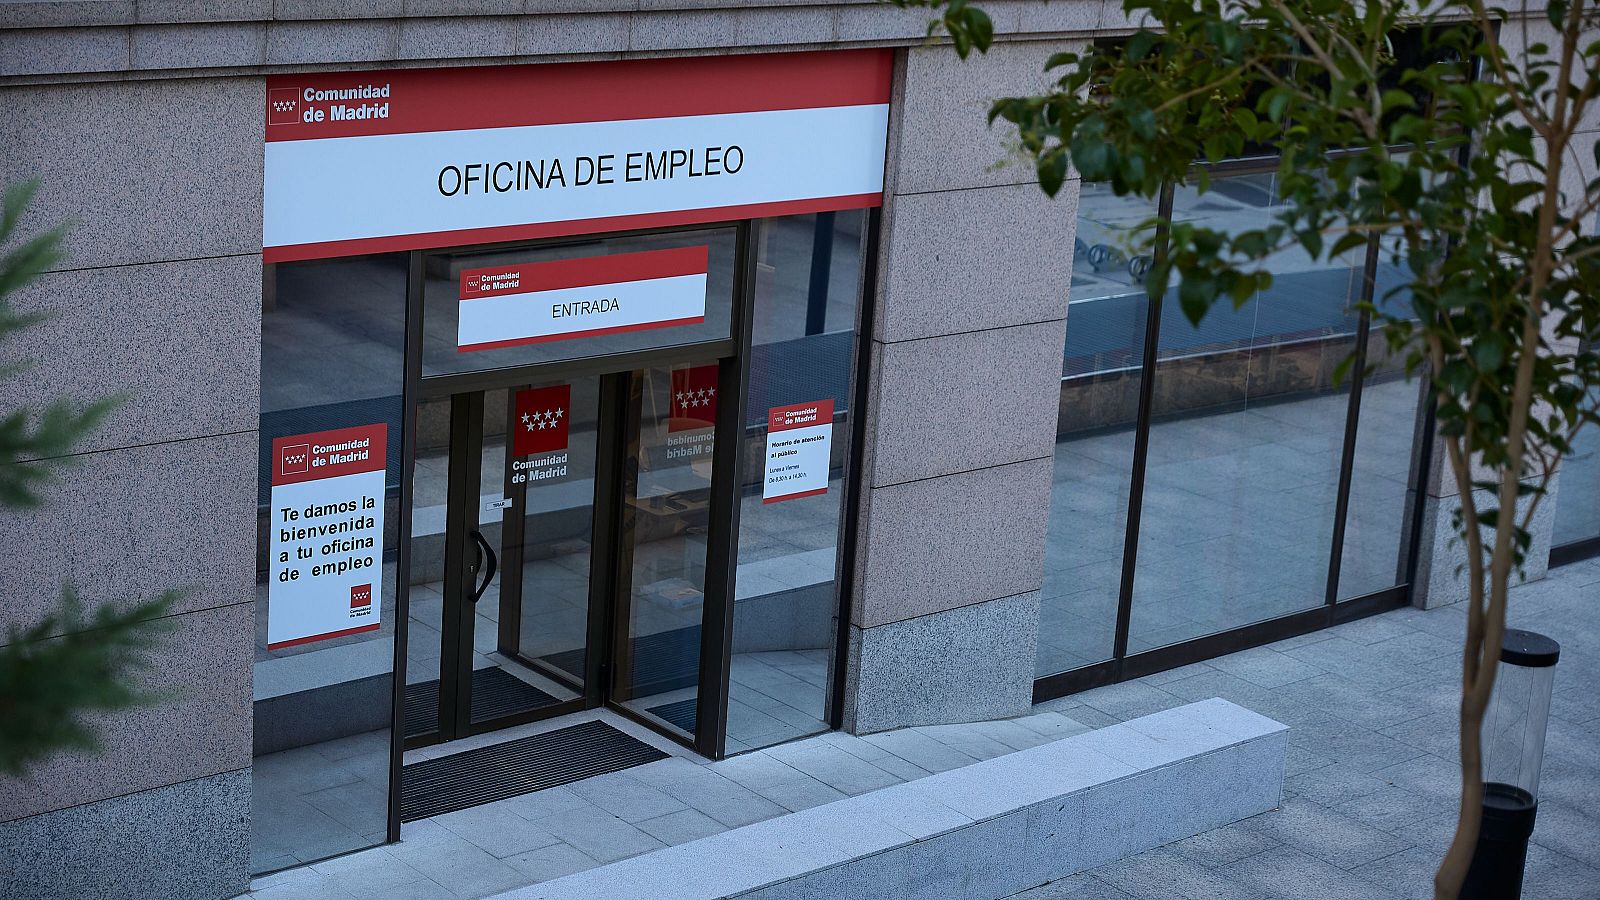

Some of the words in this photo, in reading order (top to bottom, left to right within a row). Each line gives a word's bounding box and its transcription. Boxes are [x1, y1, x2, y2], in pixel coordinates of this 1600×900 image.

[303, 83, 390, 102] Comunidad
[303, 106, 325, 123] de
[330, 103, 389, 121] Madrid
[438, 158, 566, 197] OFICINA
[574, 155, 615, 186] DE
[625, 145, 744, 182] EMPLEO
[481, 272, 520, 282] Comunidad
[481, 283, 491, 291] de
[492, 280, 519, 290] Madrid
[552, 298, 620, 318] ENTRADA
[785, 408, 817, 417] Comunidad
[794, 414, 817, 423] Madrid
[312, 438, 370, 455] Comunidad
[771, 440, 792, 448] Horario
[801, 435, 825, 443] atención
[312, 457, 327, 467] de
[329, 450, 369, 465] Madrid
[513, 453, 568, 471] Comunidad
[777, 450, 798, 458] público
[512, 473, 525, 484] de
[529, 466, 567, 481] Madrid
[281, 507, 299, 522] Te
[304, 504, 356, 519] damos
[362, 496, 375, 509] la
[281, 515, 374, 543] bienvenida
[280, 551, 288, 563] a
[297, 546, 312, 560] tu
[321, 537, 374, 555] oficina
[279, 568, 299, 582] de
[312, 556, 373, 576] empleo
